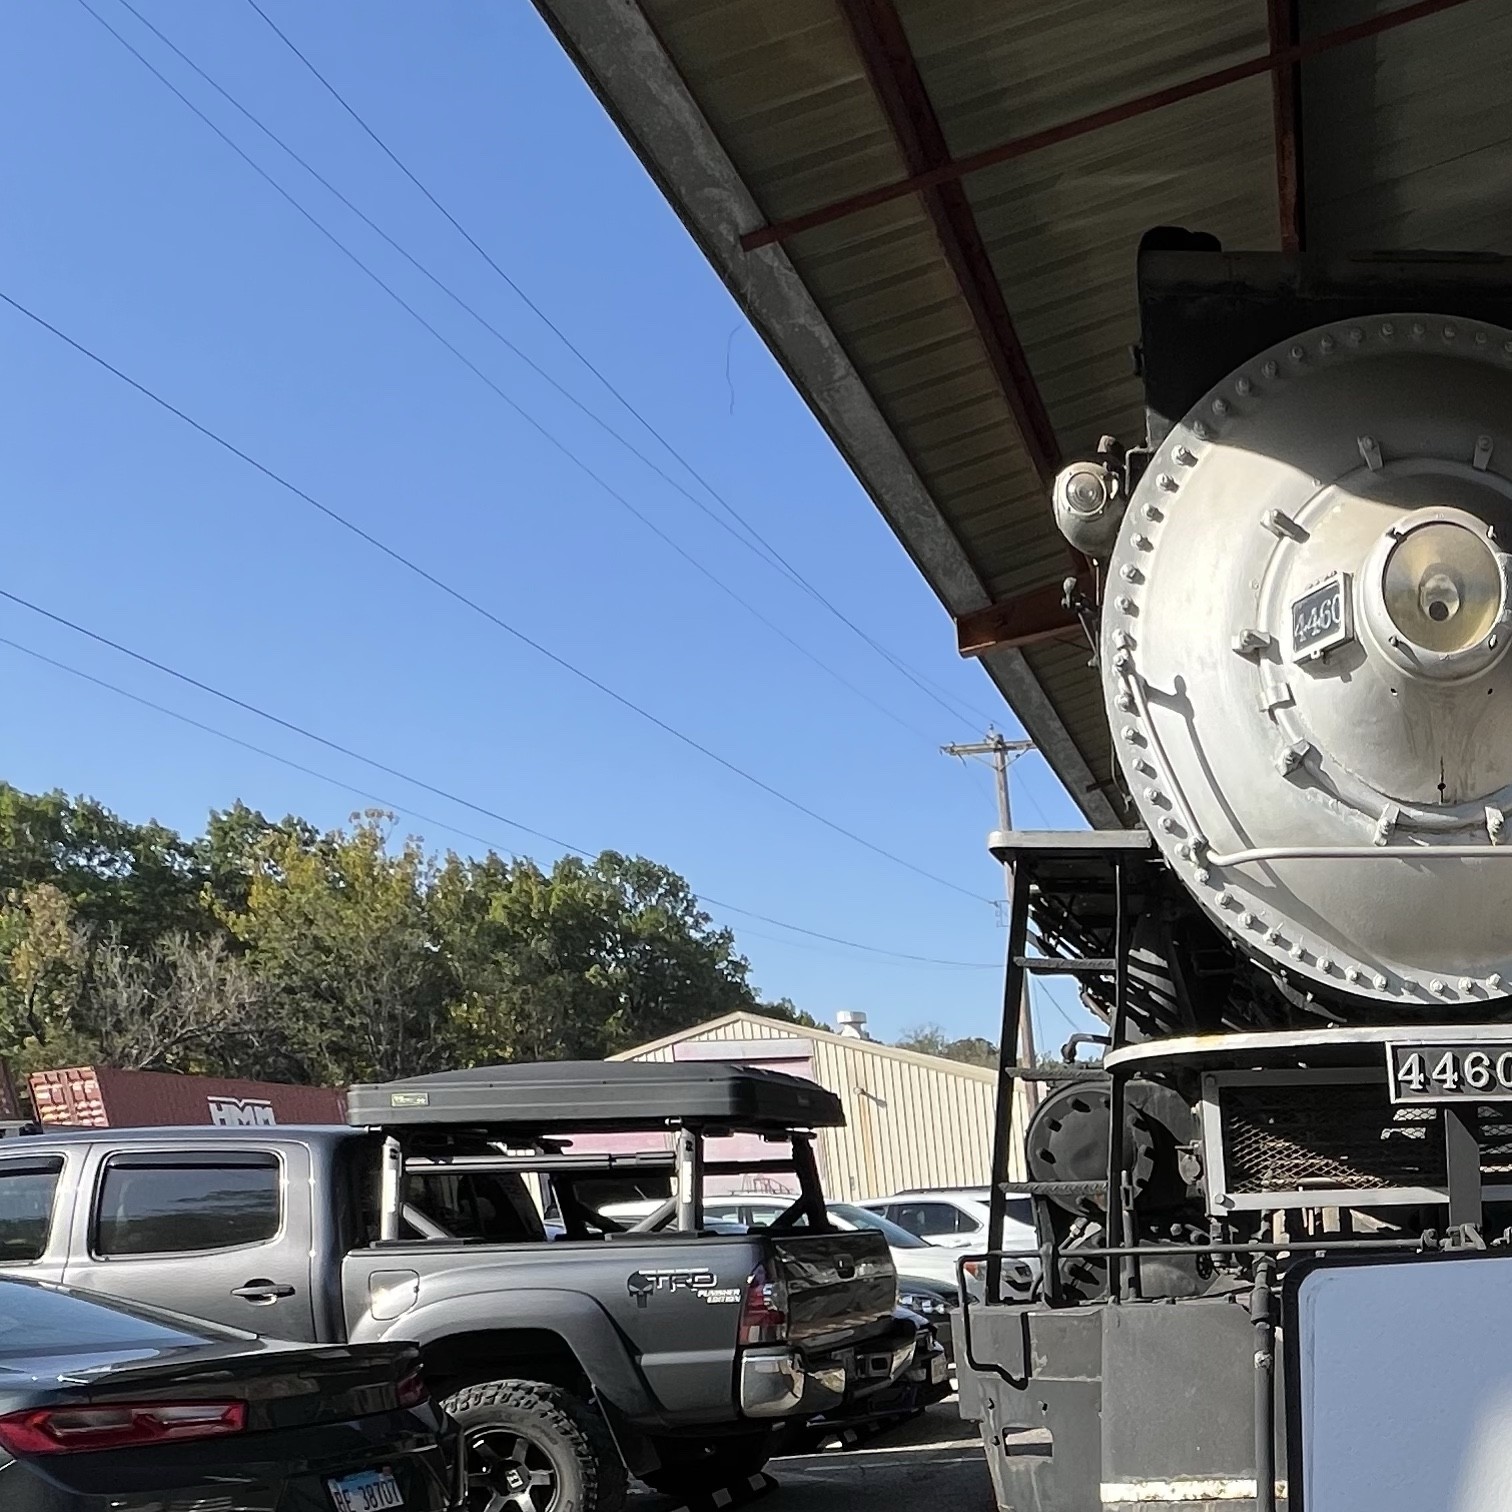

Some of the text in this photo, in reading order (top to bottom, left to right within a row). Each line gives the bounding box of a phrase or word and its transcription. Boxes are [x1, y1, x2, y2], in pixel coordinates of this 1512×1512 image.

[1294, 593, 1341, 643] 4460
[208, 1100, 276, 1126] HMM
[640, 1268, 718, 1293] TRD
